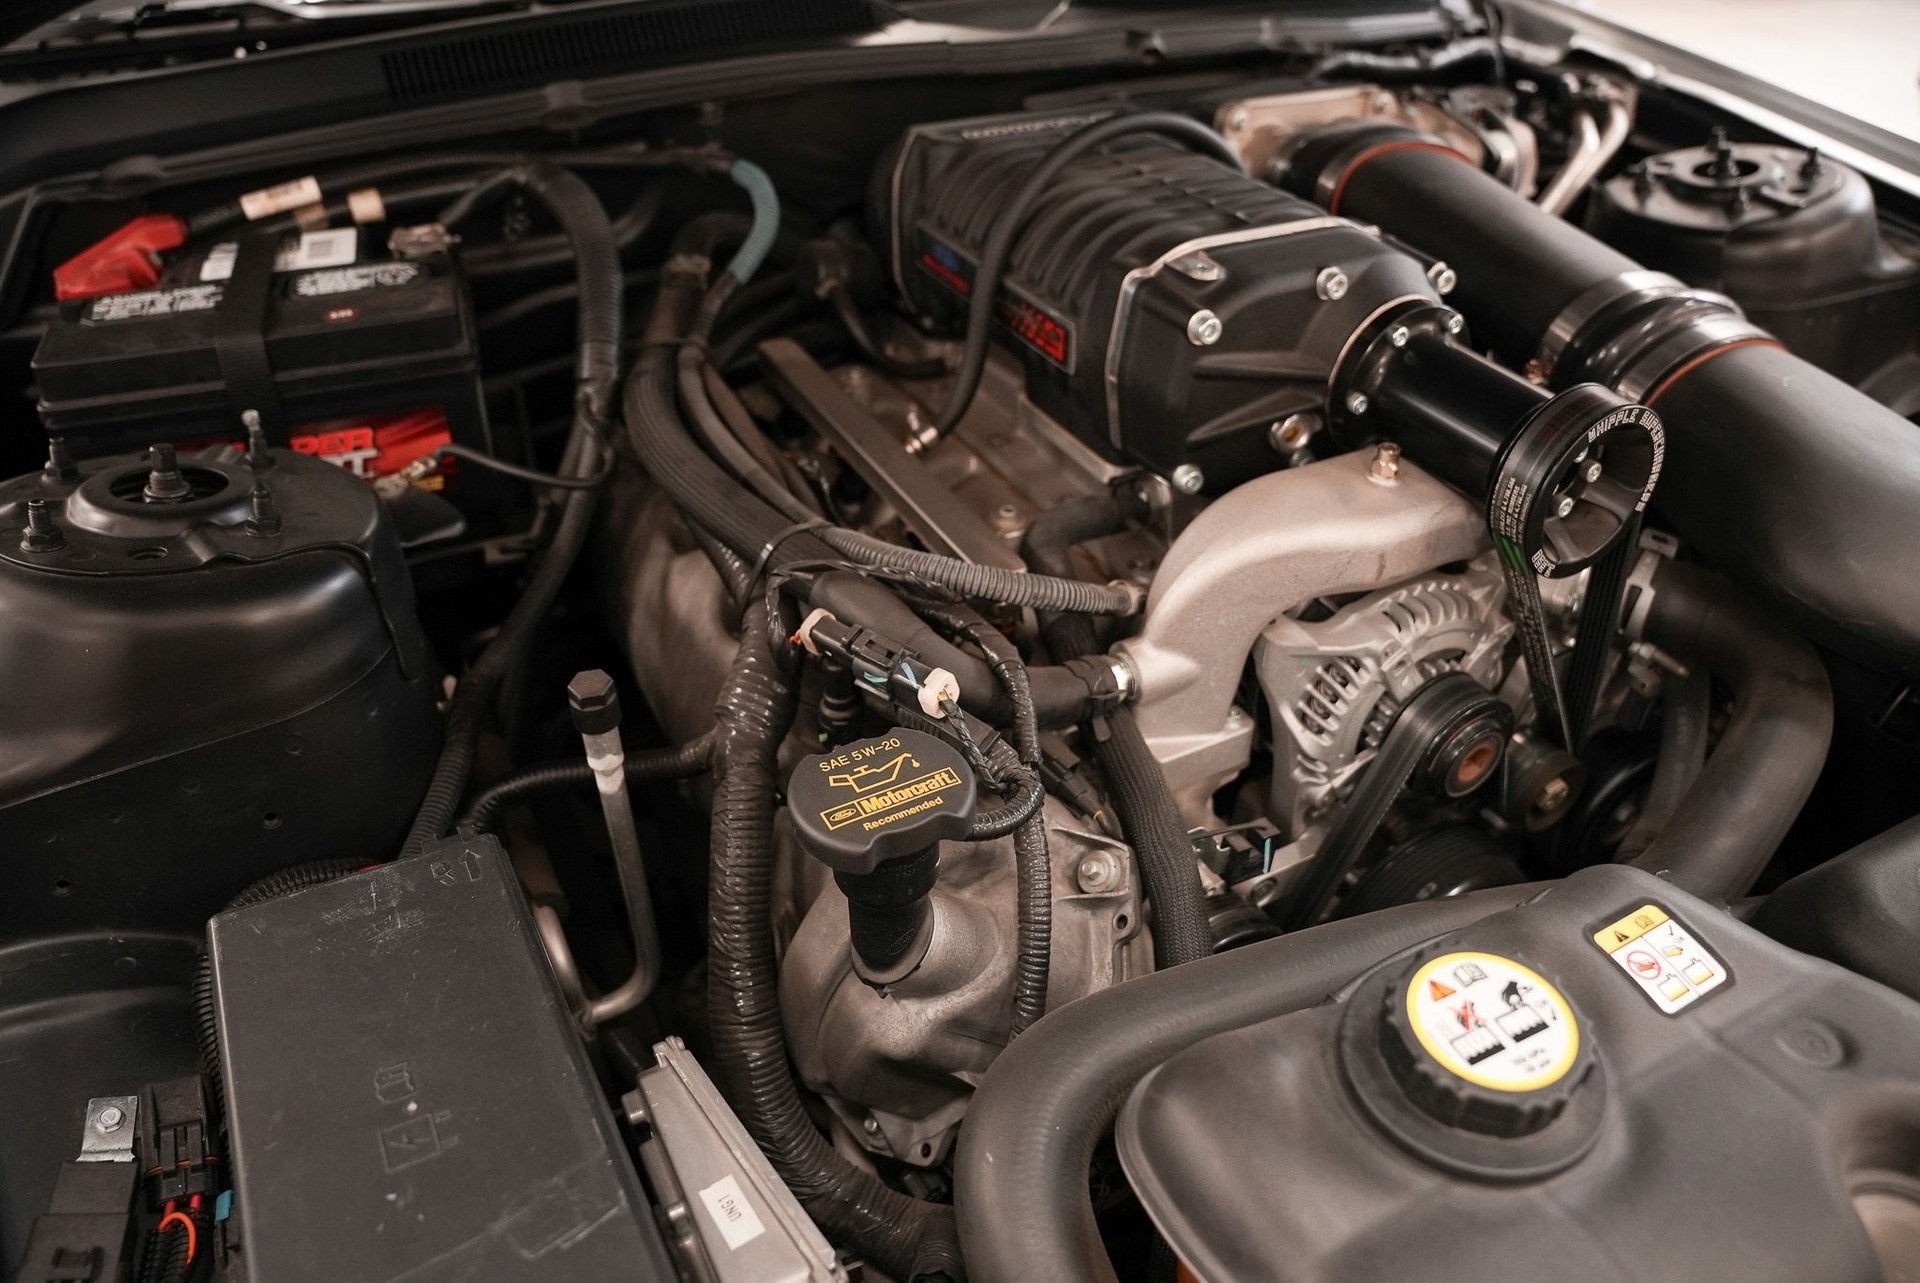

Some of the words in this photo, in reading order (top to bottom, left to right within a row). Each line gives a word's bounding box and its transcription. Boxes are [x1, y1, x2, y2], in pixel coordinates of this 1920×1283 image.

[1587, 408, 1640, 444] WHIPPLE
[819, 755, 850, 772] SAE
[851, 737, 901, 761] 5W-20
[863, 796, 944, 831] Recommended
